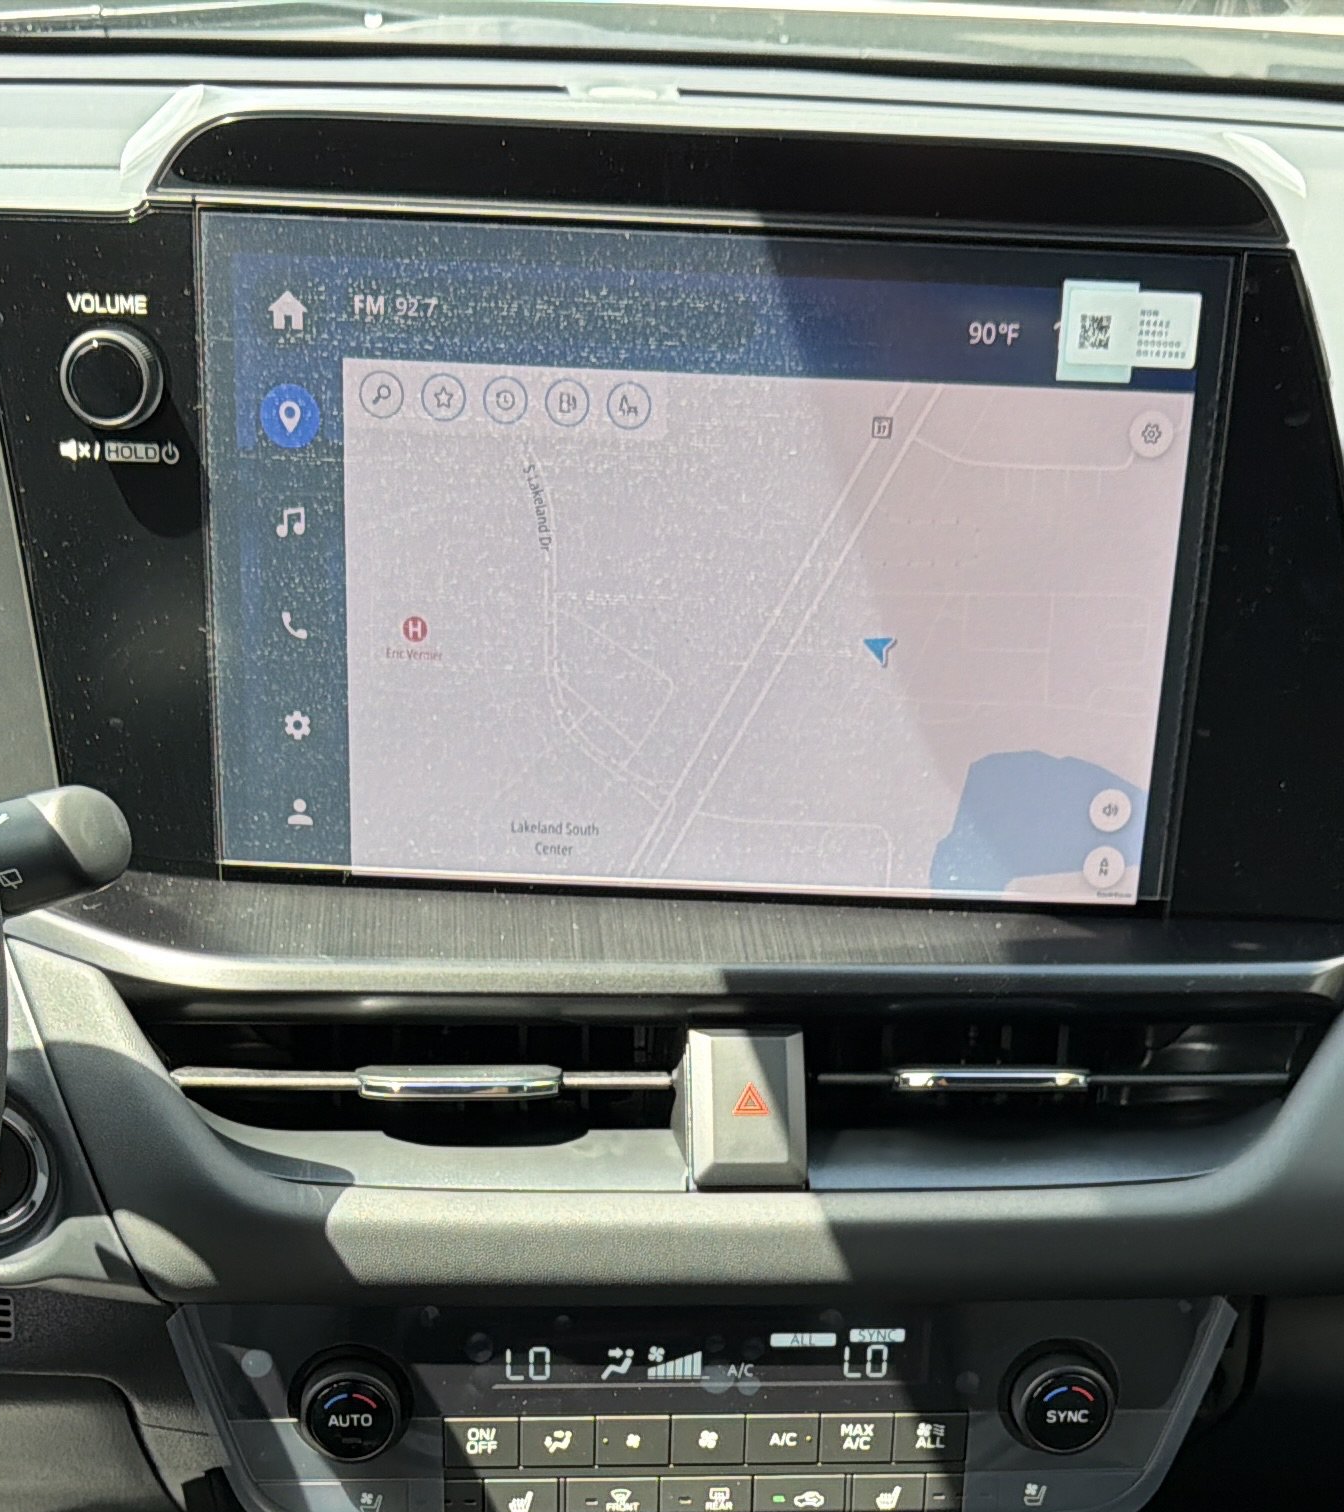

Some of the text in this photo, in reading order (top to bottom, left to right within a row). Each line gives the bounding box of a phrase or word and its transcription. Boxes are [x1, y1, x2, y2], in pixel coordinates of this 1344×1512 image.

[66, 291, 148, 315] VOLUME
[353, 294, 438, 318] FM 92.7
[968, 321, 1020, 346] 90°F
[106, 444, 158, 461] HOLD
[527, 474, 550, 533] Lakeland
[539, 536, 552, 552] Dr
[511, 820, 600, 836] Lakeland South
[535, 841, 574, 856] Center
[789, 1329, 898, 1346] ALL SYNC
[505, 1344, 889, 1381] LO A/C LO
[327, 1413, 374, 1428] AUTO
[1045, 1409, 1090, 1424] SYNC
[467, 1427, 497, 1442] ON/
[840, 1423, 875, 1437] MAX
[768, 1432, 798, 1447] A/C
[842, 1436, 872, 1451] A/C
[915, 1436, 946, 1450] ALL
[465, 1440, 498, 1455] OFF
[605, 1501, 640, 1512] FRONT
[705, 1500, 733, 1511] REAR
